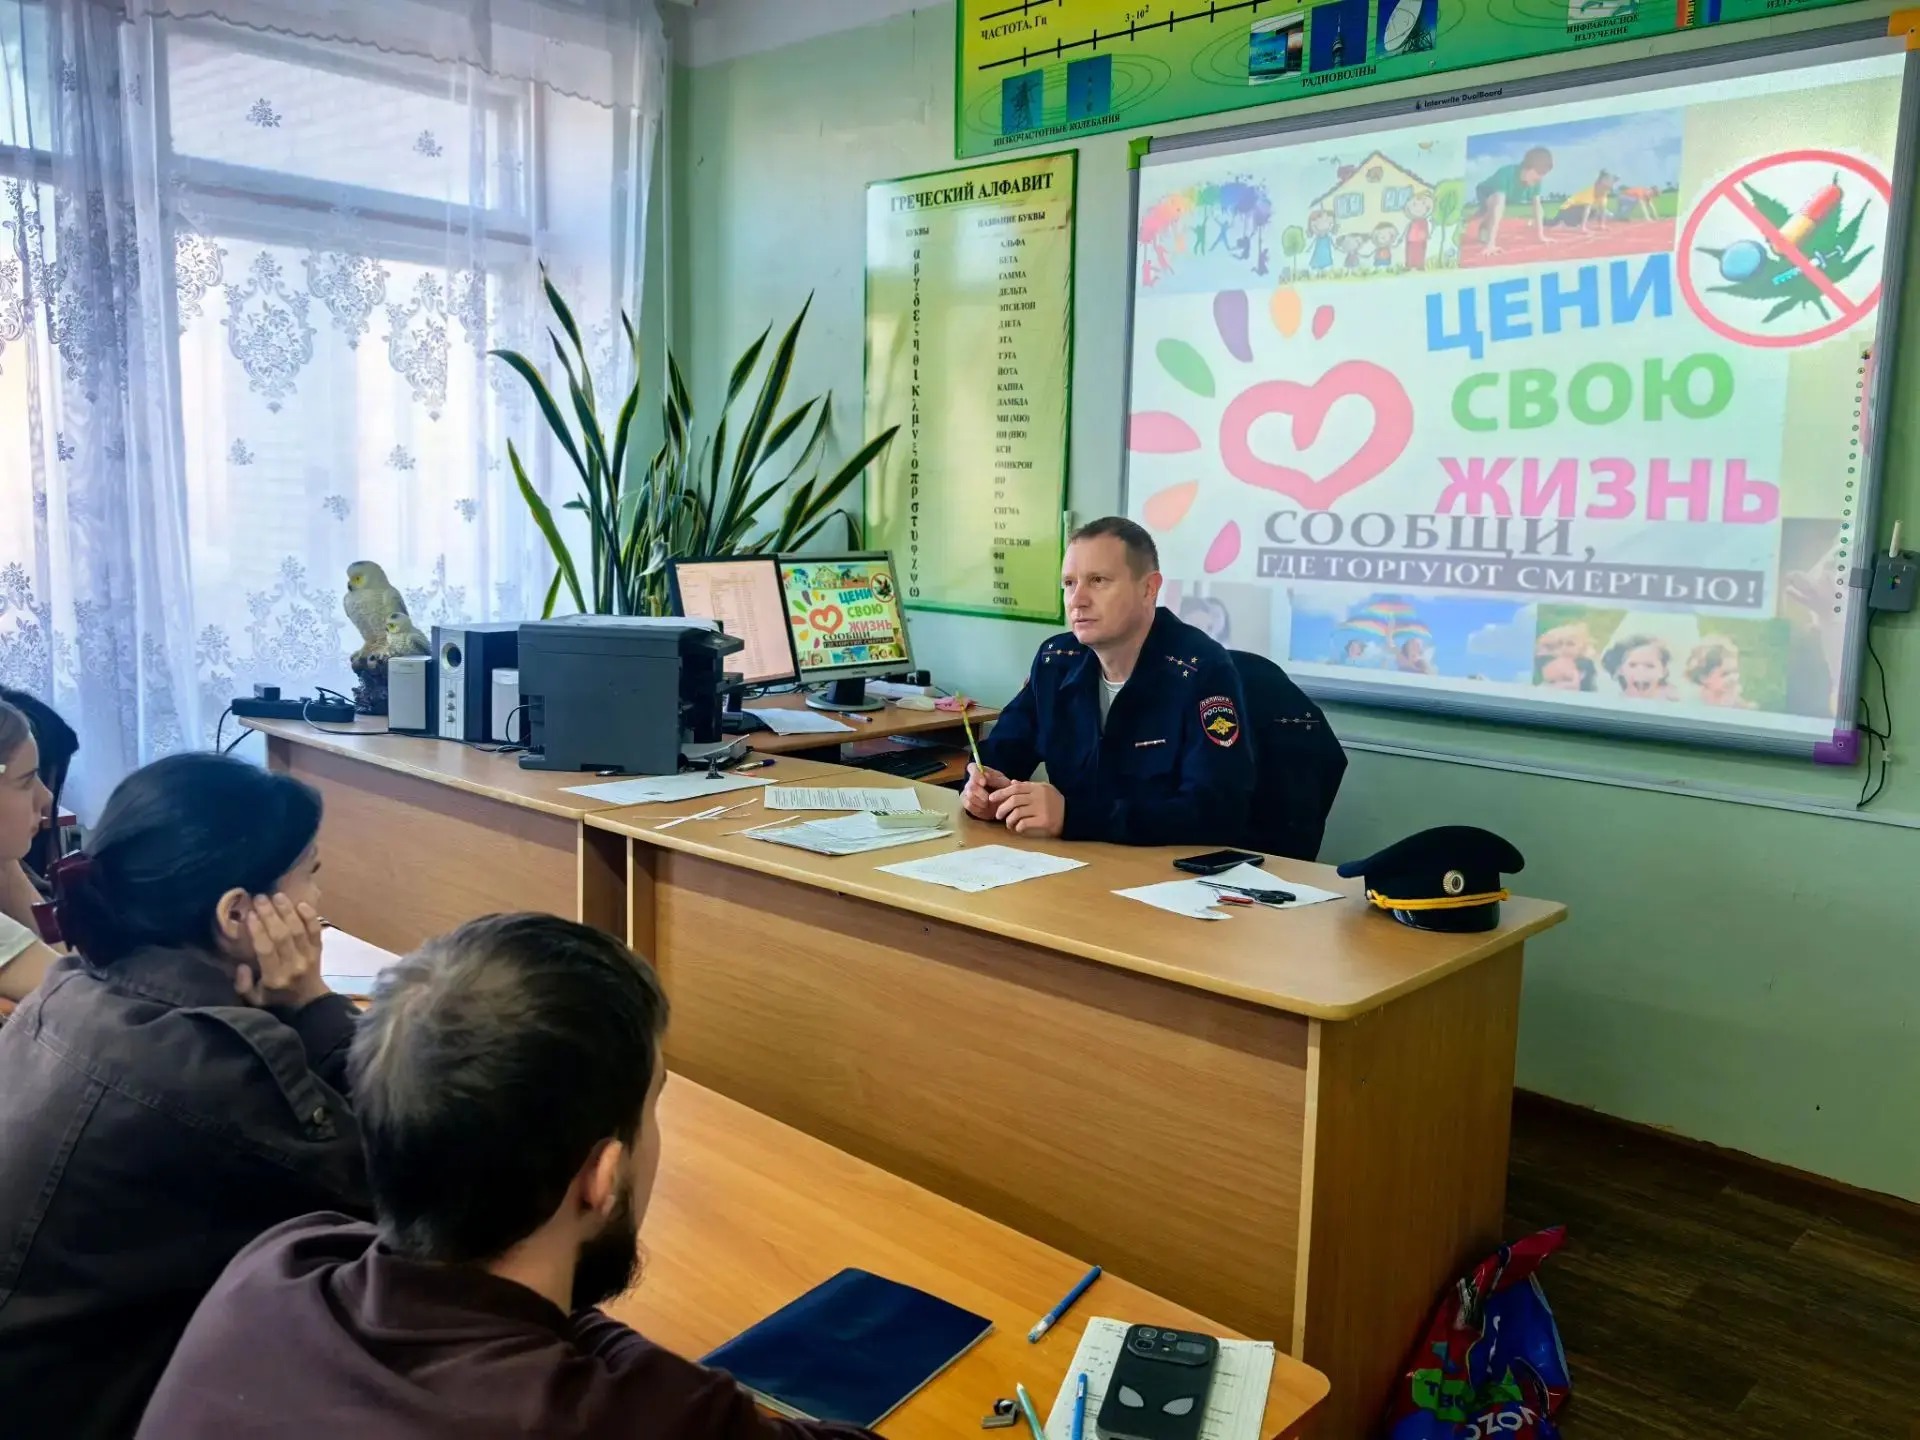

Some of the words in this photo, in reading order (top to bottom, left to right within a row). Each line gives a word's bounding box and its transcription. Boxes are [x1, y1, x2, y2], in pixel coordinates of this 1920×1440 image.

[981, 20, 1032, 40] ЧАСТОТА,
[1574, 26, 1629, 41] ИЗЛУЧЕНИЕ
[1302, 66, 1377, 87] РАДИОВОЛНЫ
[1424, 95, 1460, 107] Interwrite
[1462, 88, 1503, 101] DualBoard
[993, 125, 1067, 146] НИЗКОЧАСТОТНЫЕ
[1069, 114, 1120, 132] КОЛЕБАНИЯ
[890, 181, 974, 212] ГРЕЧЕСКИЙ
[978, 173, 1054, 199] АЛФАВИТ
[1018, 211, 1046, 223] БУКВЫ
[999, 271, 1027, 280] ГАММА
[998, 286, 1028, 297] ДЕЛЬТА
[1426, 253, 1674, 359] ЦЕНИ
[1451, 353, 1734, 431] СВОЮ
[1434, 456, 1780, 524] ЖИЗНЬ
[1264, 510, 1596, 564] СООБЩИ,
[1262, 554, 1316, 580] ГДЕ
[1324, 556, 1504, 587] ТОРГУЮТ
[1516, 566, 1757, 603] СМЕРТЬЮ!
[838, 588, 873, 605] ЦЕНИ
[847, 604, 884, 618] СВОЮ
[848, 620, 893, 633] ЖИЗНЬ
[1203, 707, 1234, 720] РОССИЯ
